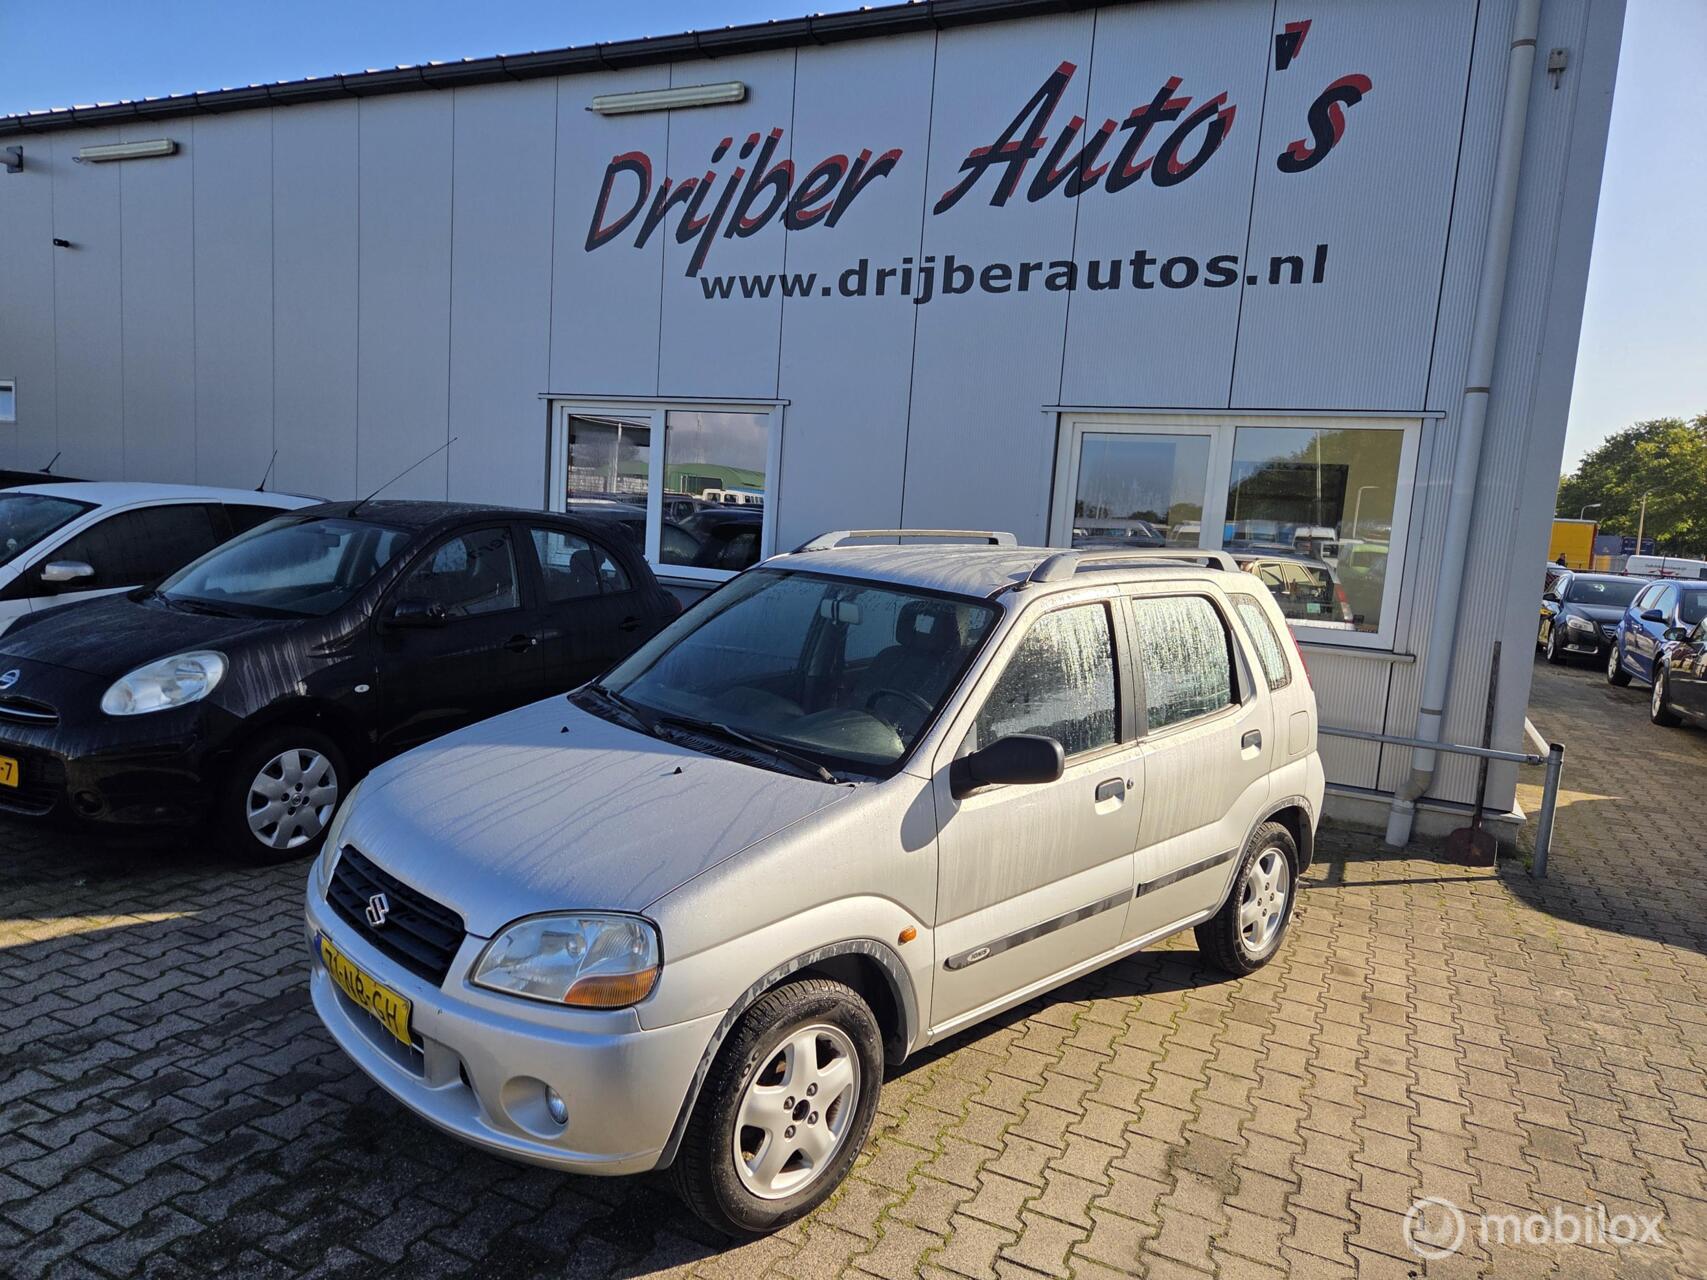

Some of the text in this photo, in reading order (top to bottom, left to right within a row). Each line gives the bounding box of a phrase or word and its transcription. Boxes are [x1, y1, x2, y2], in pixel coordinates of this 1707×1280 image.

[585, 19, 1373, 277] Drijber Auto's
[700, 244, 1329, 305] www.drijberautos.nl
